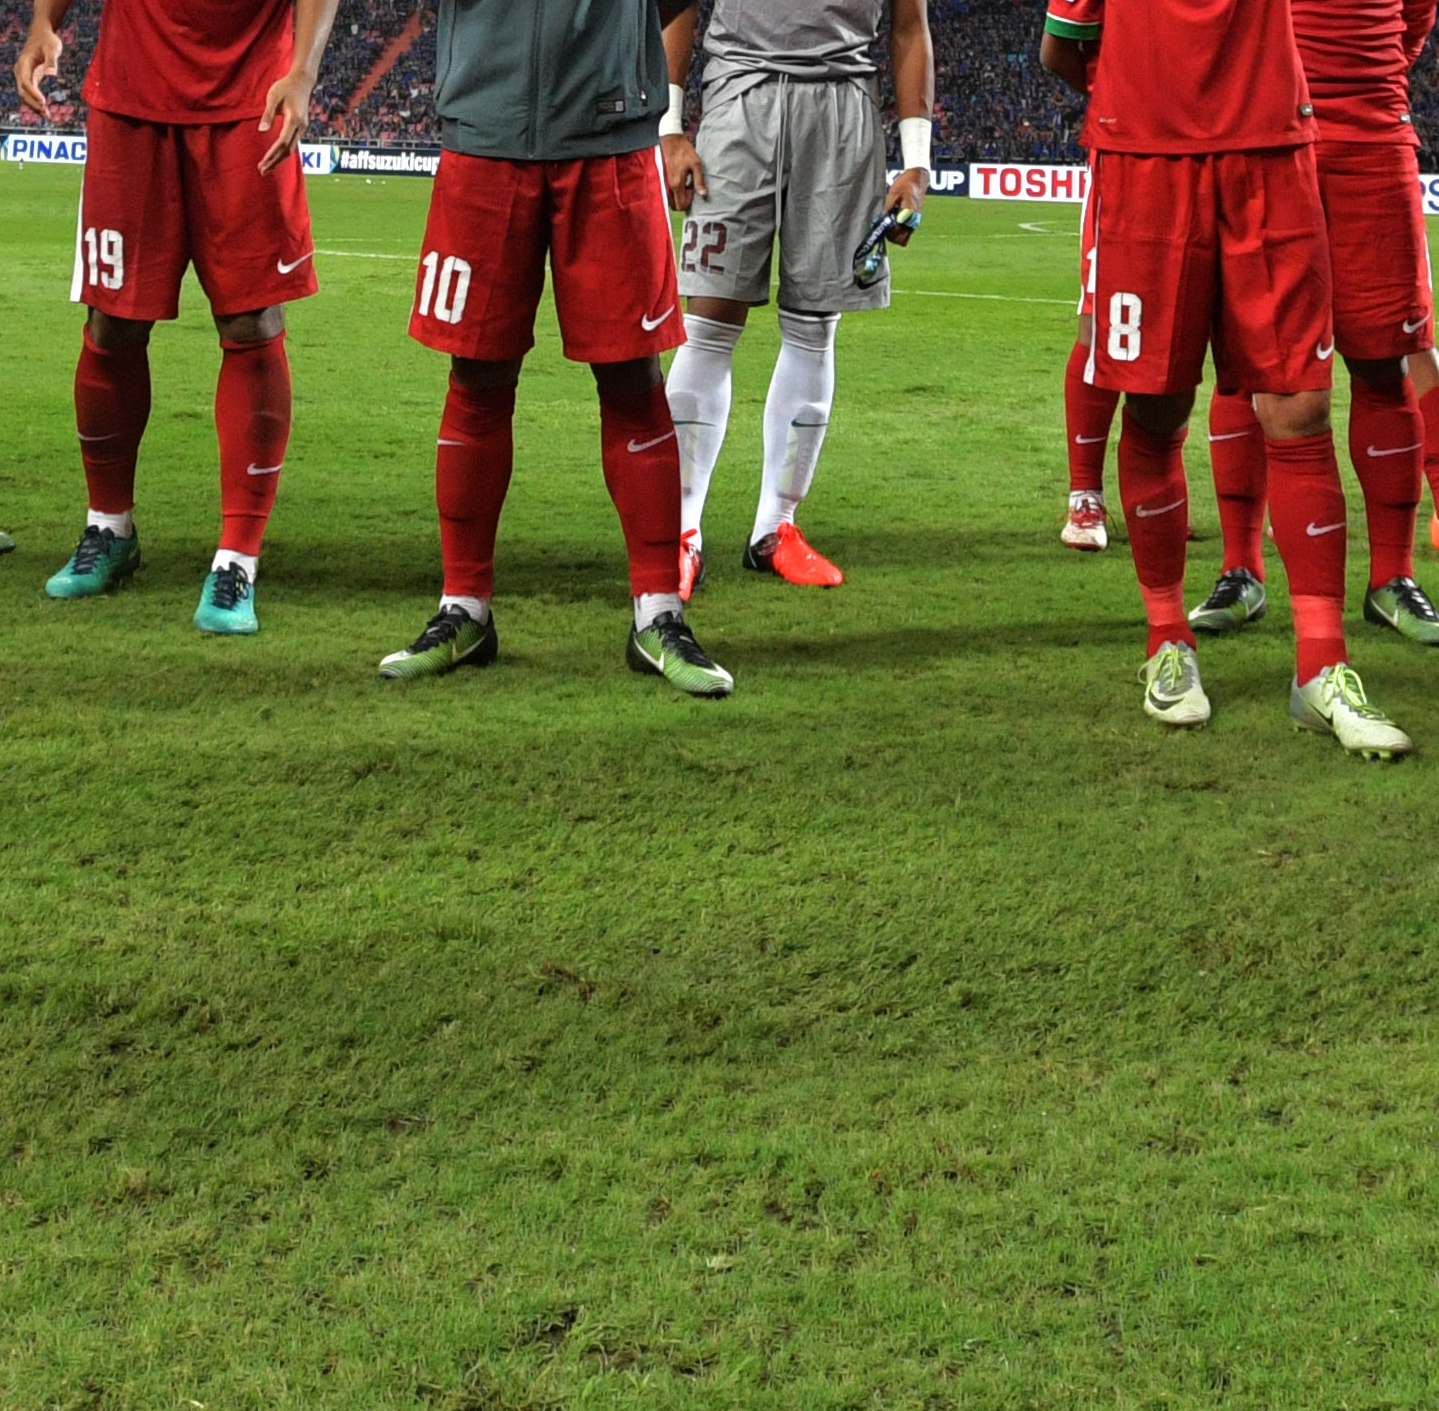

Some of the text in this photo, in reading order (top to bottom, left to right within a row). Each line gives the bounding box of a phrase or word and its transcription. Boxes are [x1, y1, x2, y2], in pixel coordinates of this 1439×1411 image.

[84, 227, 124, 290] 19
[681, 220, 727, 276] 22
[418, 250, 472, 325] 10
[1107, 292, 1142, 362] 8
